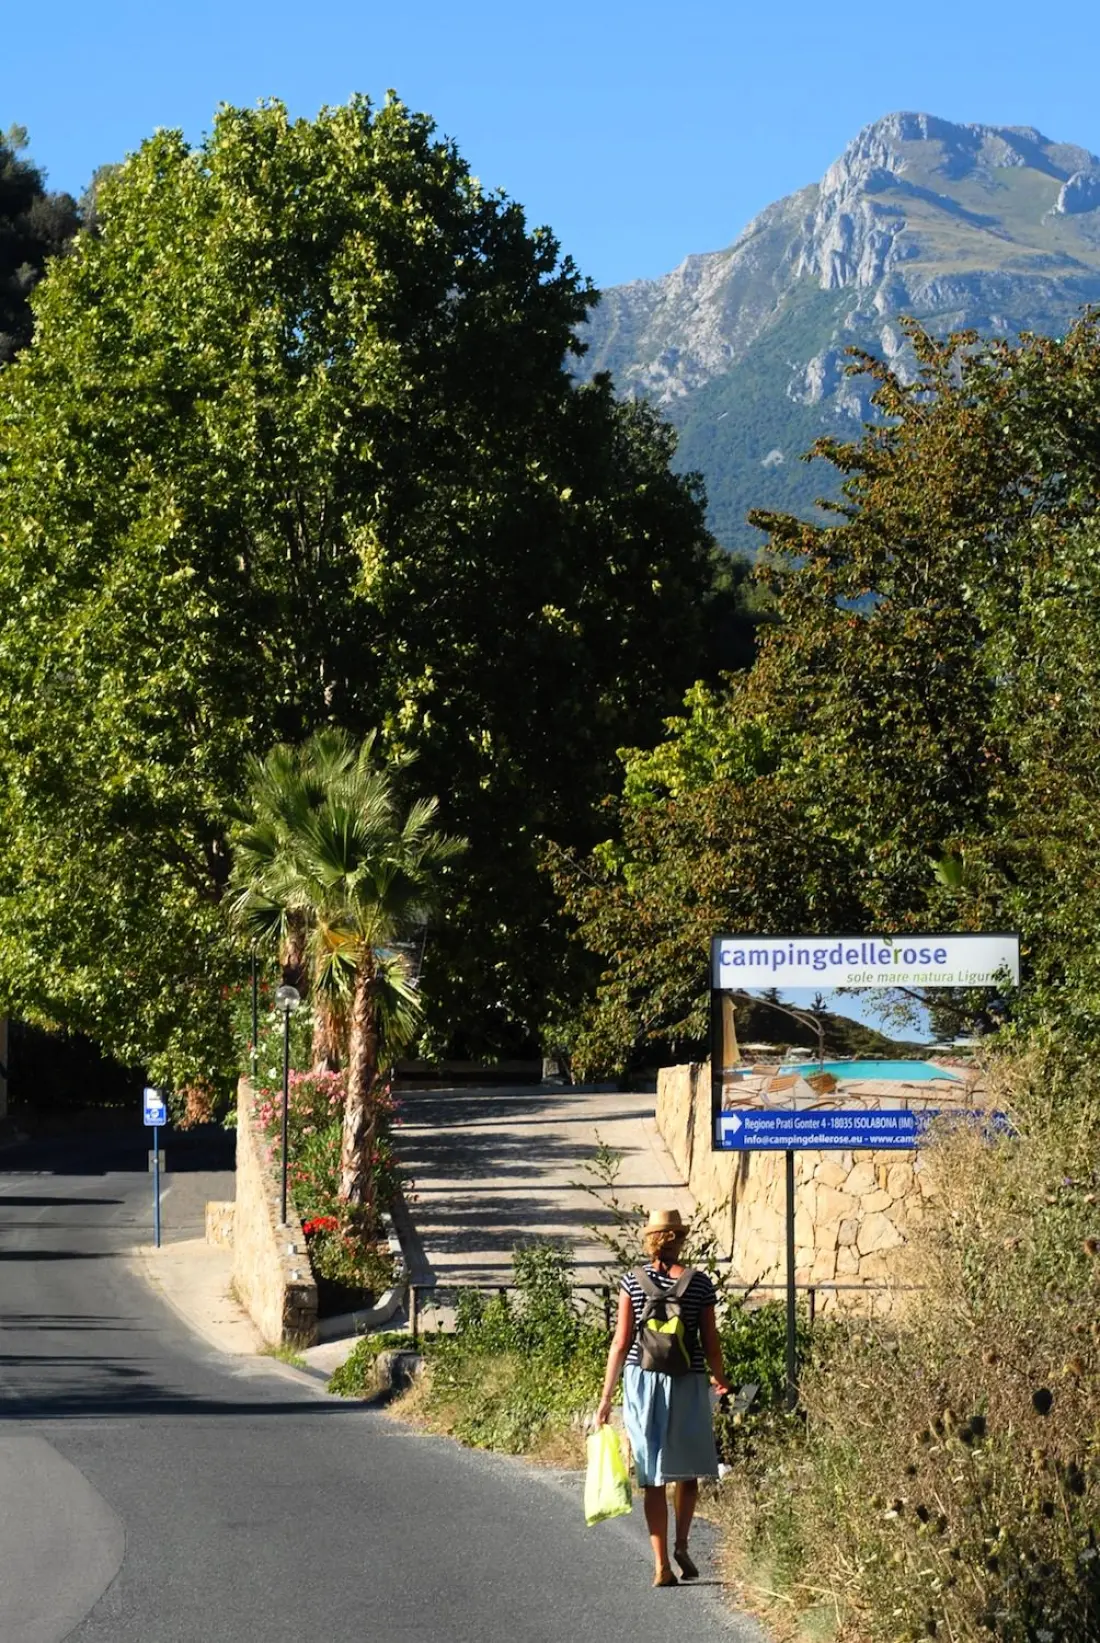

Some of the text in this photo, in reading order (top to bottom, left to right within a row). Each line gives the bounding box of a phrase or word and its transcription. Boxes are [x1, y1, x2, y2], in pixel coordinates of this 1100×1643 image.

[720, 943, 948, 971] campingdellerose
[846, 969, 998, 985] sole mare natura Ligur
[744, 1117, 775, 1132] Regione
[775, 1116, 793, 1129] Prati
[794, 1117, 820, 1129] Gonter
[820, 1117, 827, 1129] 4
[853, 1116, 897, 1129] ISOLABONA
[898, 1116, 914, 1130] (IM)
[744, 1135, 862, 1146] info@campingdellerose.eu
[869, 1136, 916, 1145] www.cam
